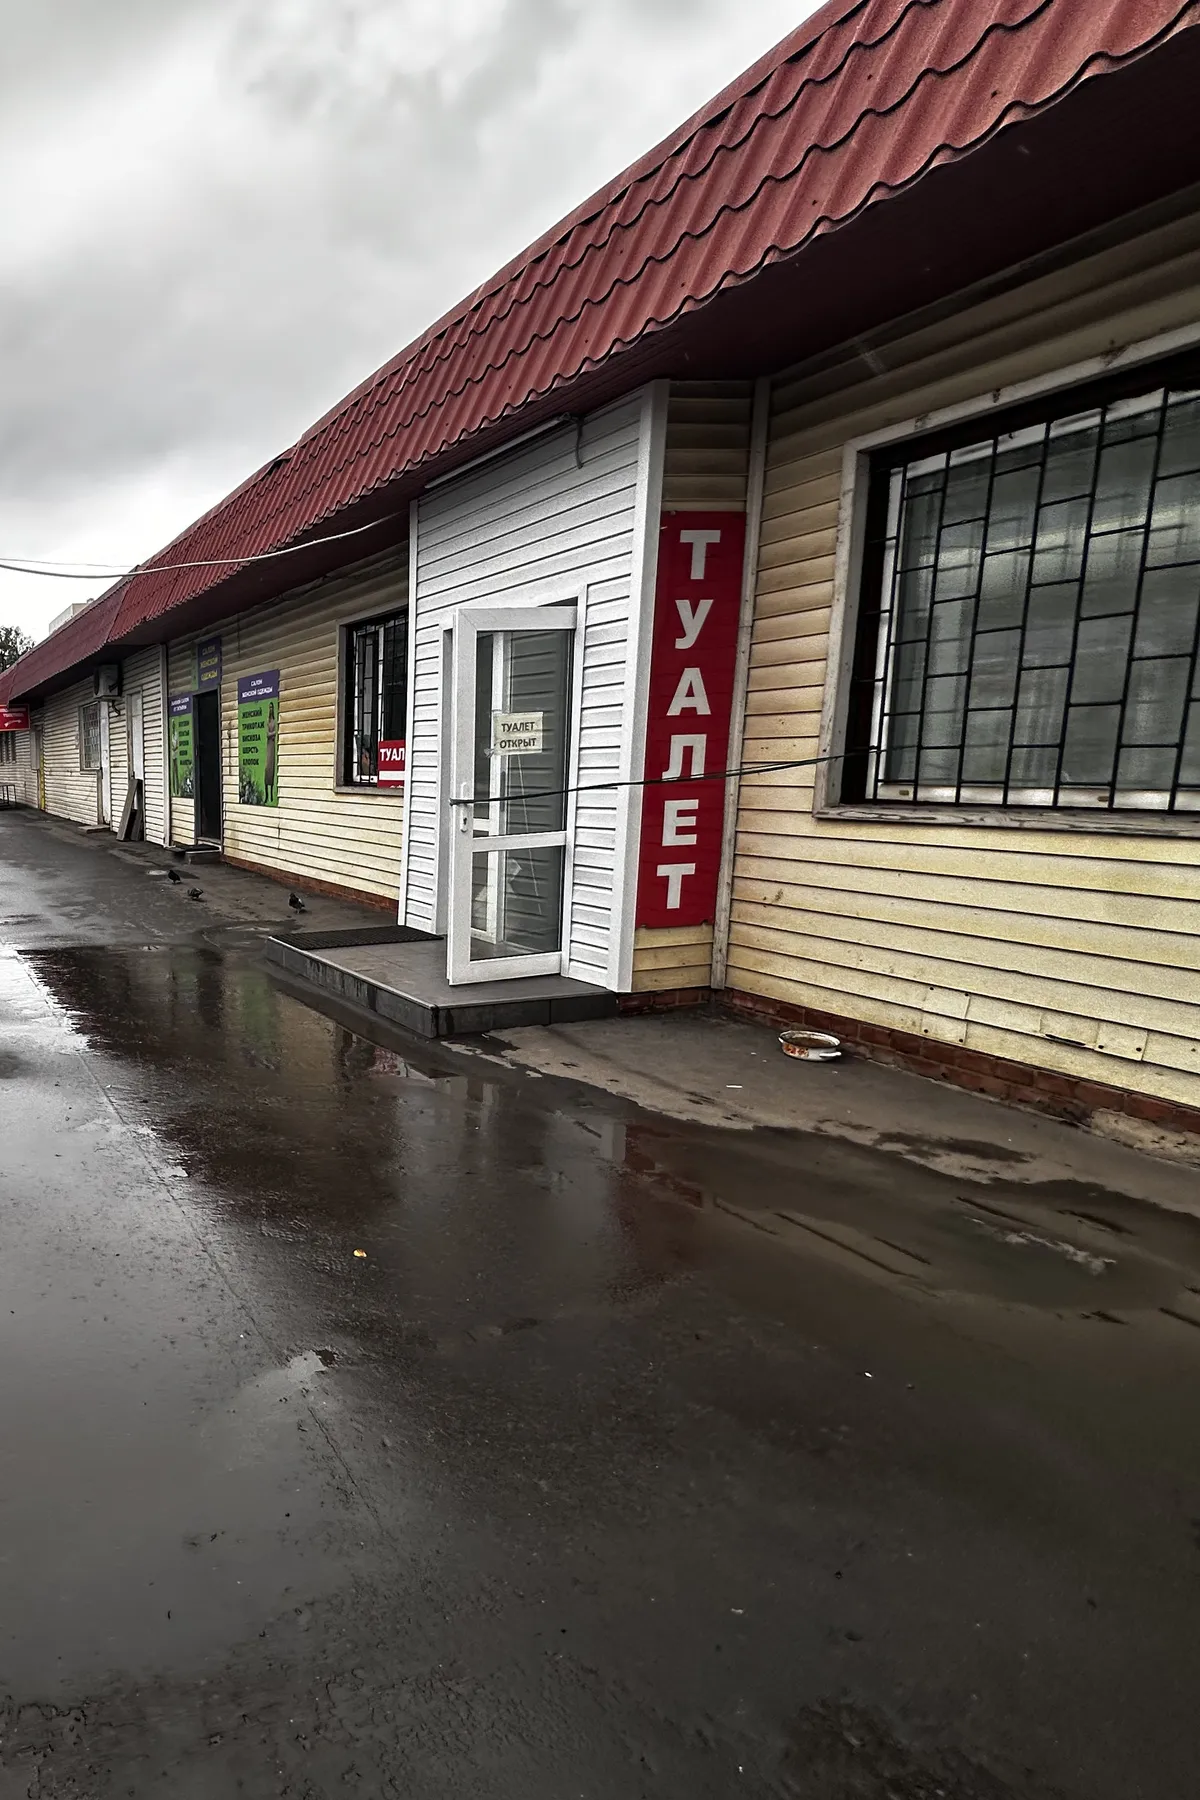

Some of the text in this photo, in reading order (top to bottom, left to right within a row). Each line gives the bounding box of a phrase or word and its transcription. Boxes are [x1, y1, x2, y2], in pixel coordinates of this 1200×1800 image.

[657, 530, 721, 909] ТУАЛЕТ
[501, 721, 535, 732] ТУАЛЕТ
[500, 738, 536, 748] ОТКРЫТ
[380, 747, 404, 761] ТУАЛ
